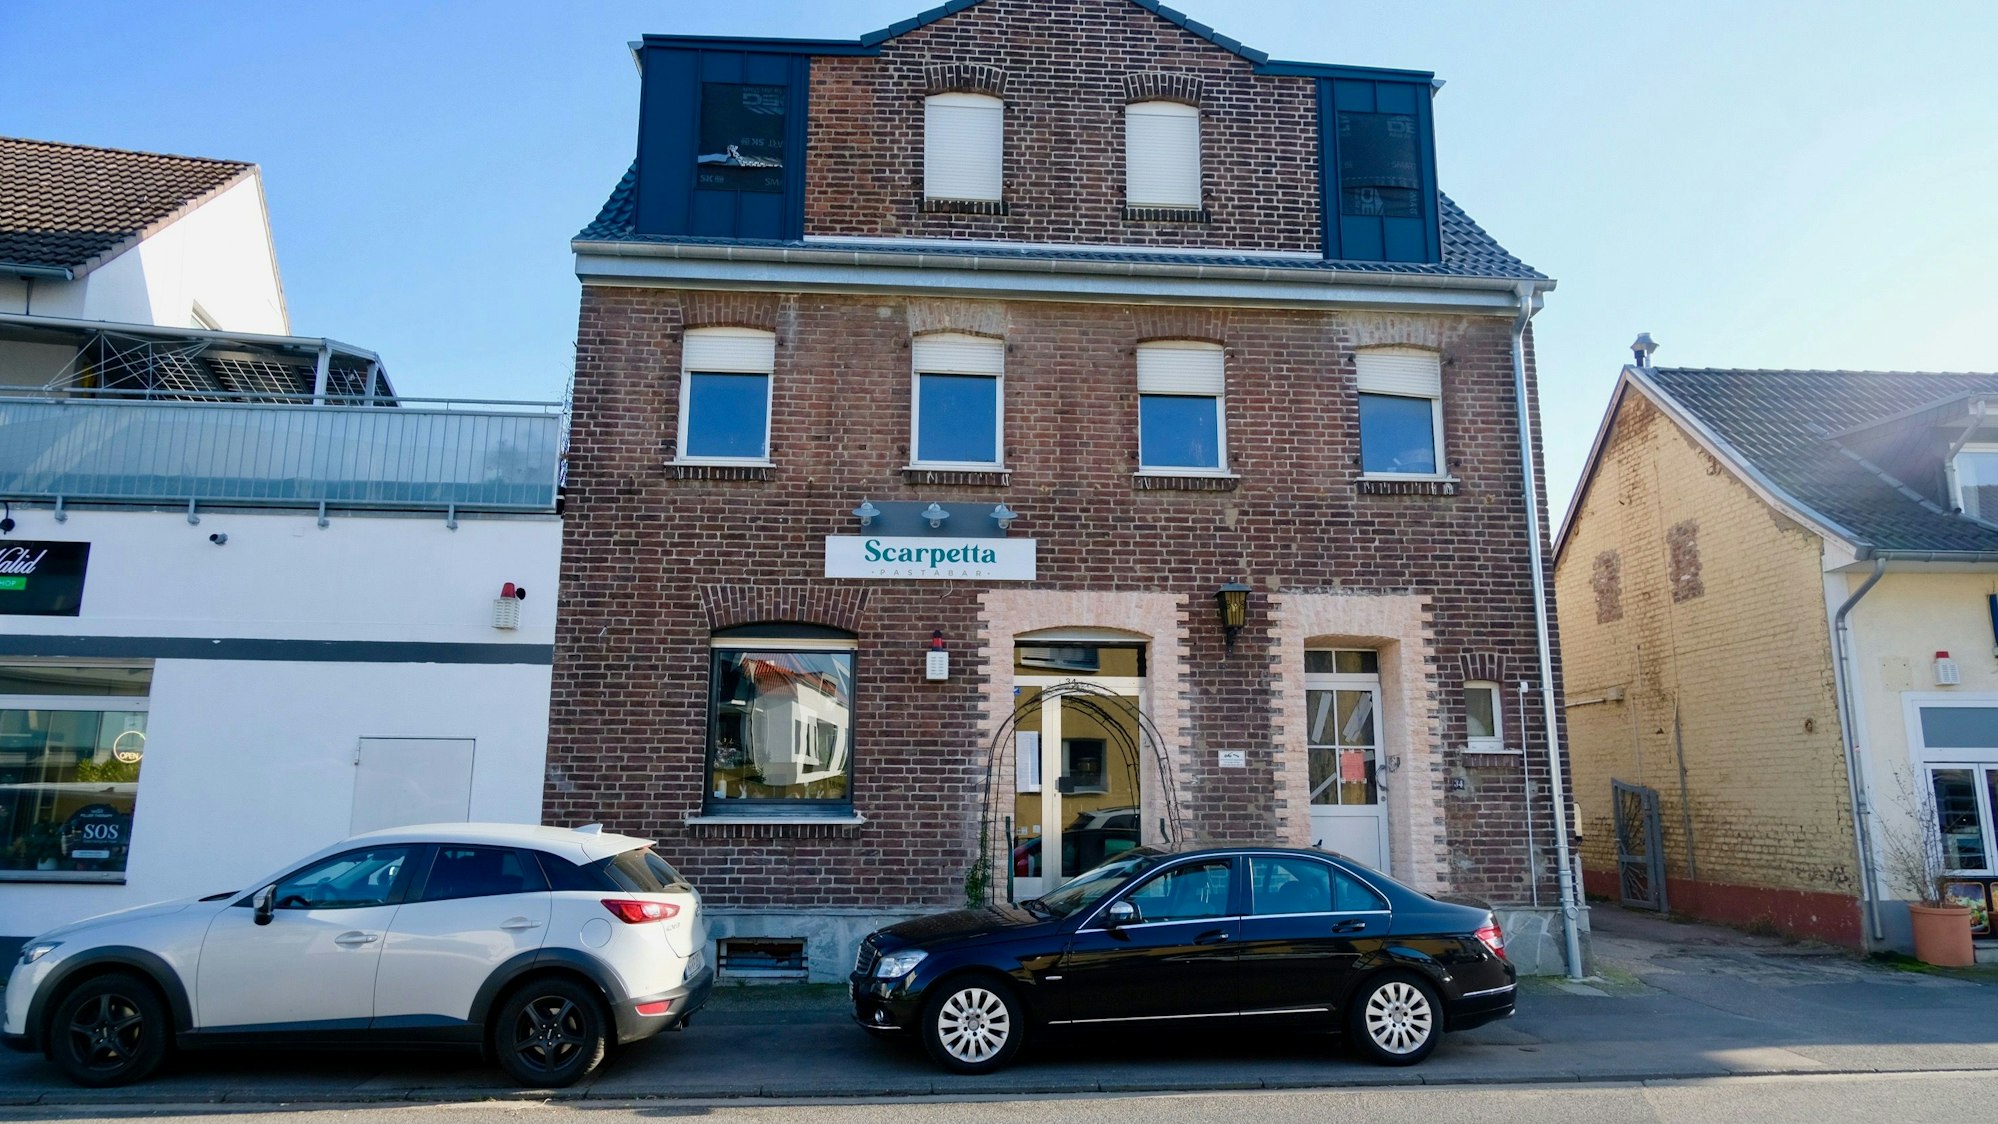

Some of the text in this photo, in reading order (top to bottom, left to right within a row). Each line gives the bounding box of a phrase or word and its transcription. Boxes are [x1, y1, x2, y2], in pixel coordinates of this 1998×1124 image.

[865, 539, 997, 568] Scarpetta
[880, 569, 982, 577] PASTABAR
[119, 752, 139, 760] OPEN
[1453, 779, 1464, 788] 34
[83, 823, 119, 840] SOS
